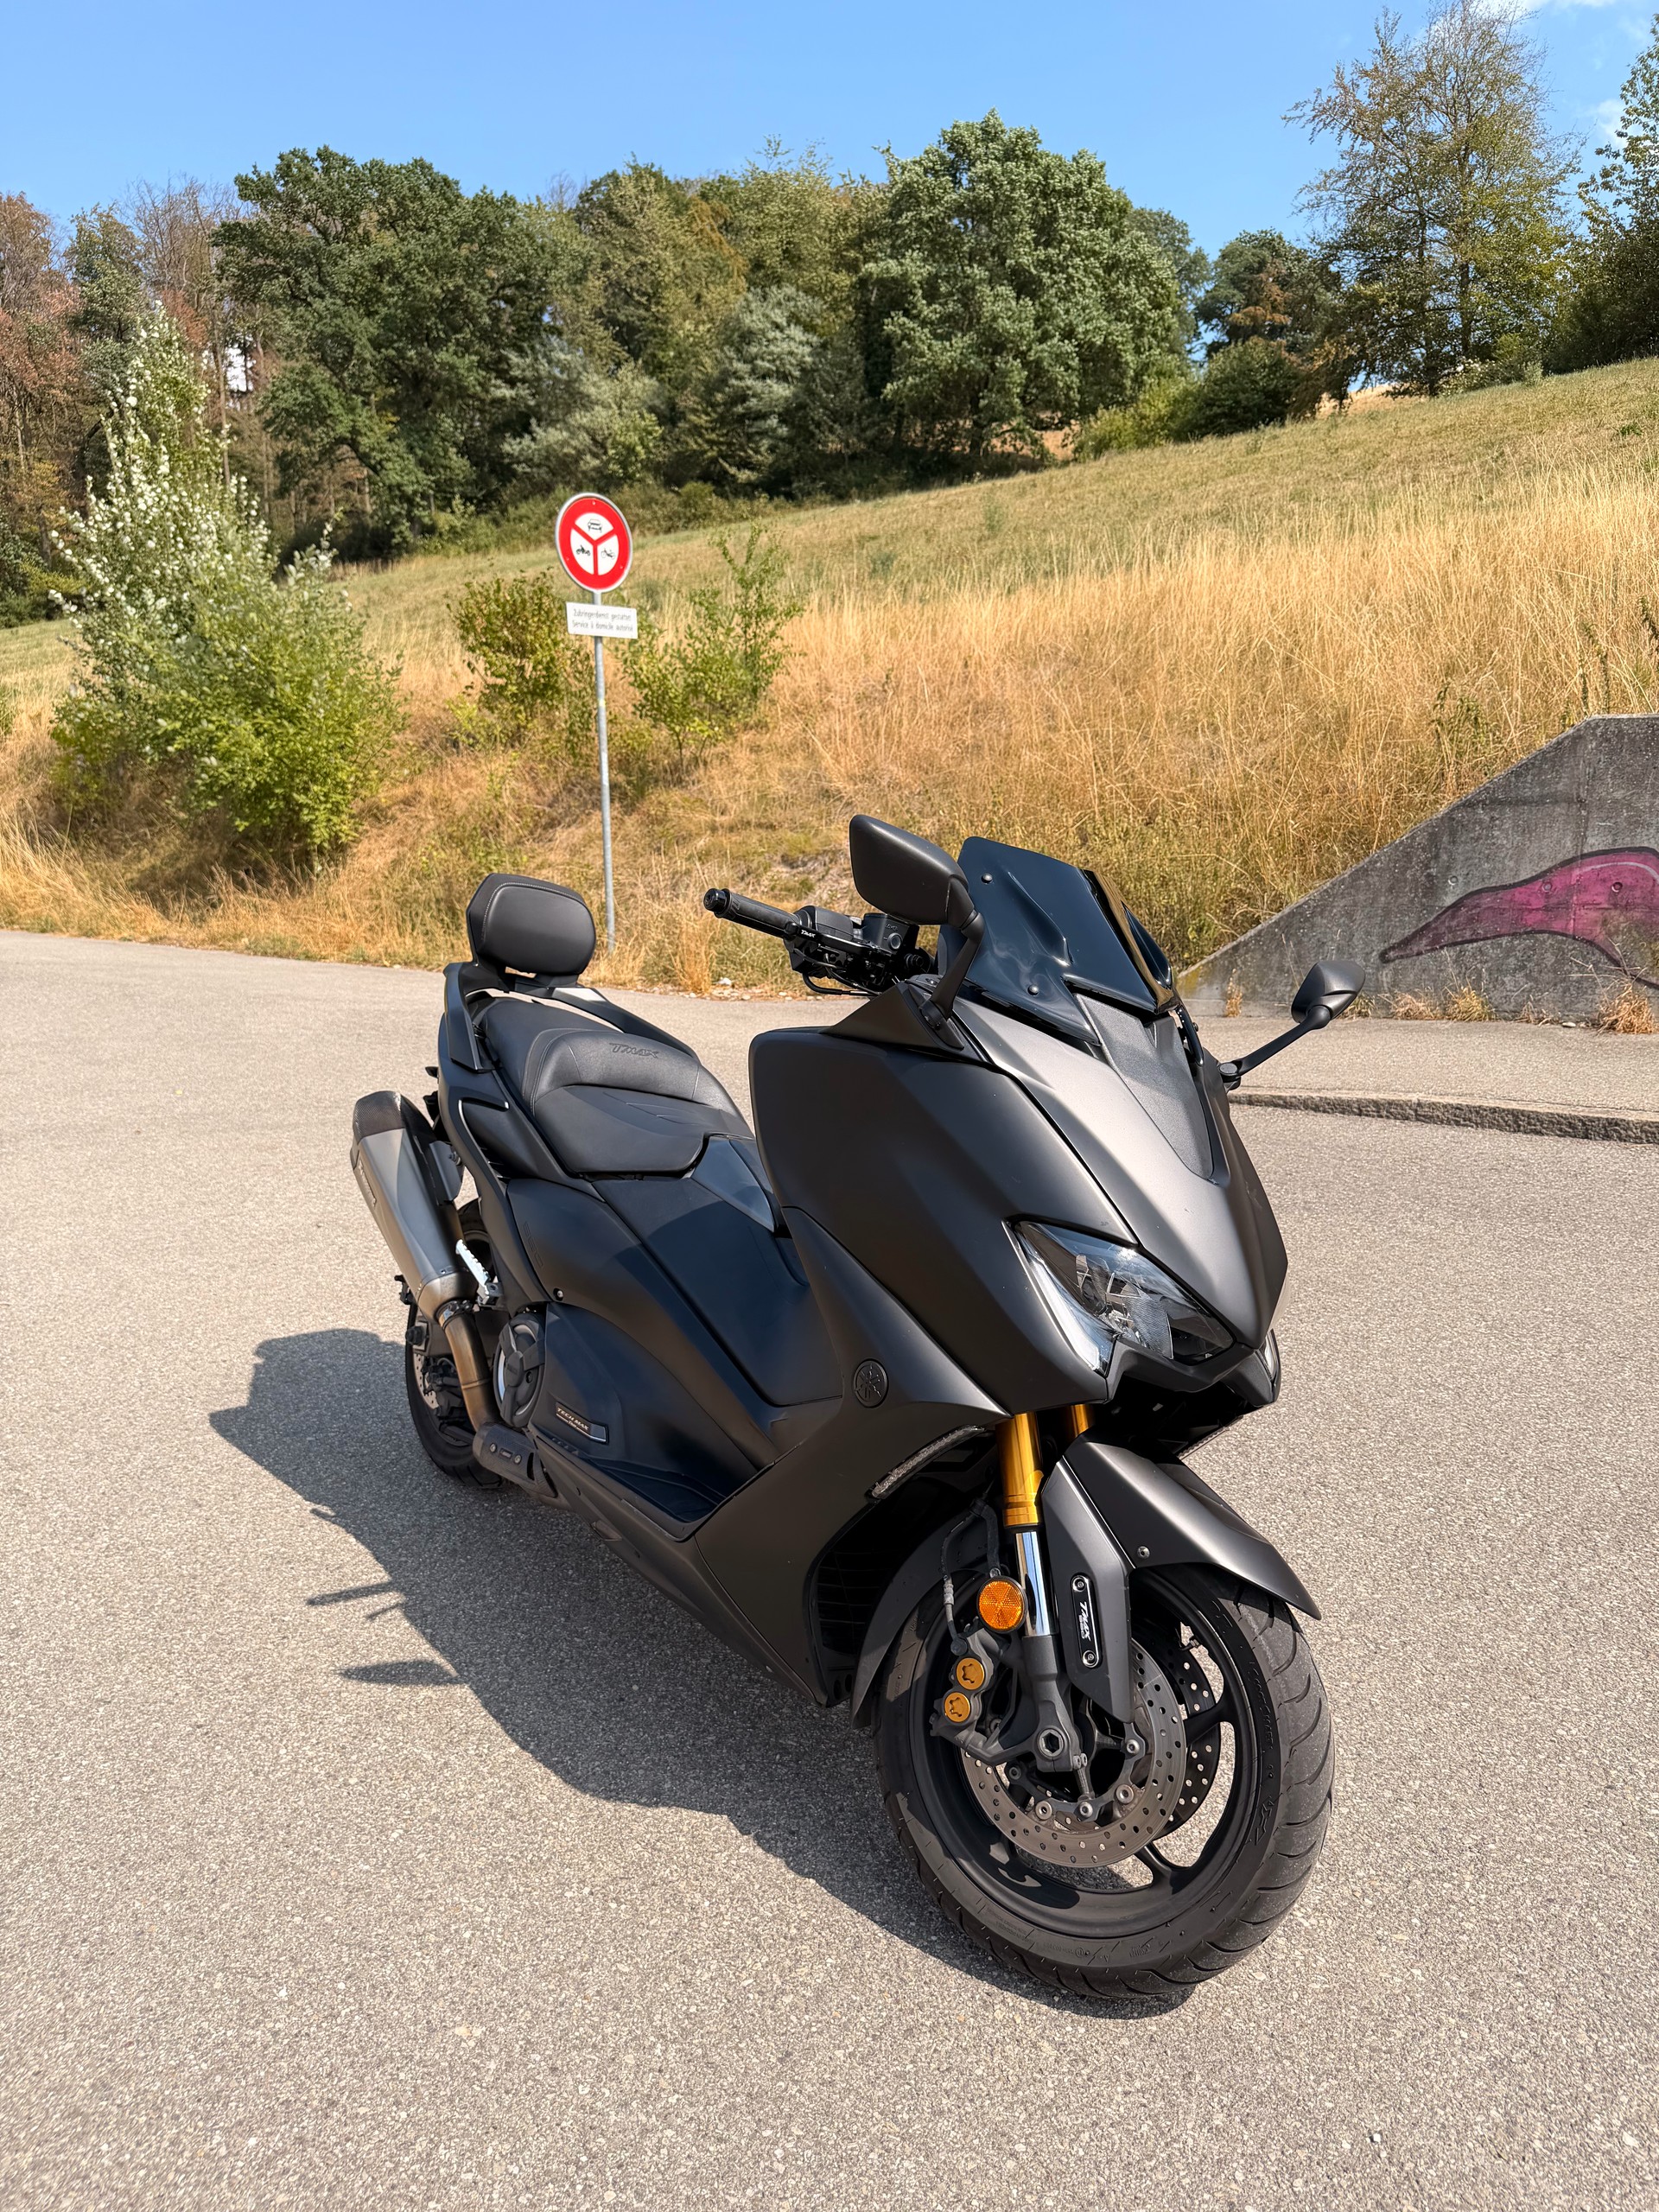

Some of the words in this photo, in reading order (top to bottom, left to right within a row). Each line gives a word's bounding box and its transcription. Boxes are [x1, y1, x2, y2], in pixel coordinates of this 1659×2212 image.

[557, 1407, 575, 1421] TECH
[574, 1419, 589, 1431] MAX
[1080, 1601, 1091, 1642] TMAX
